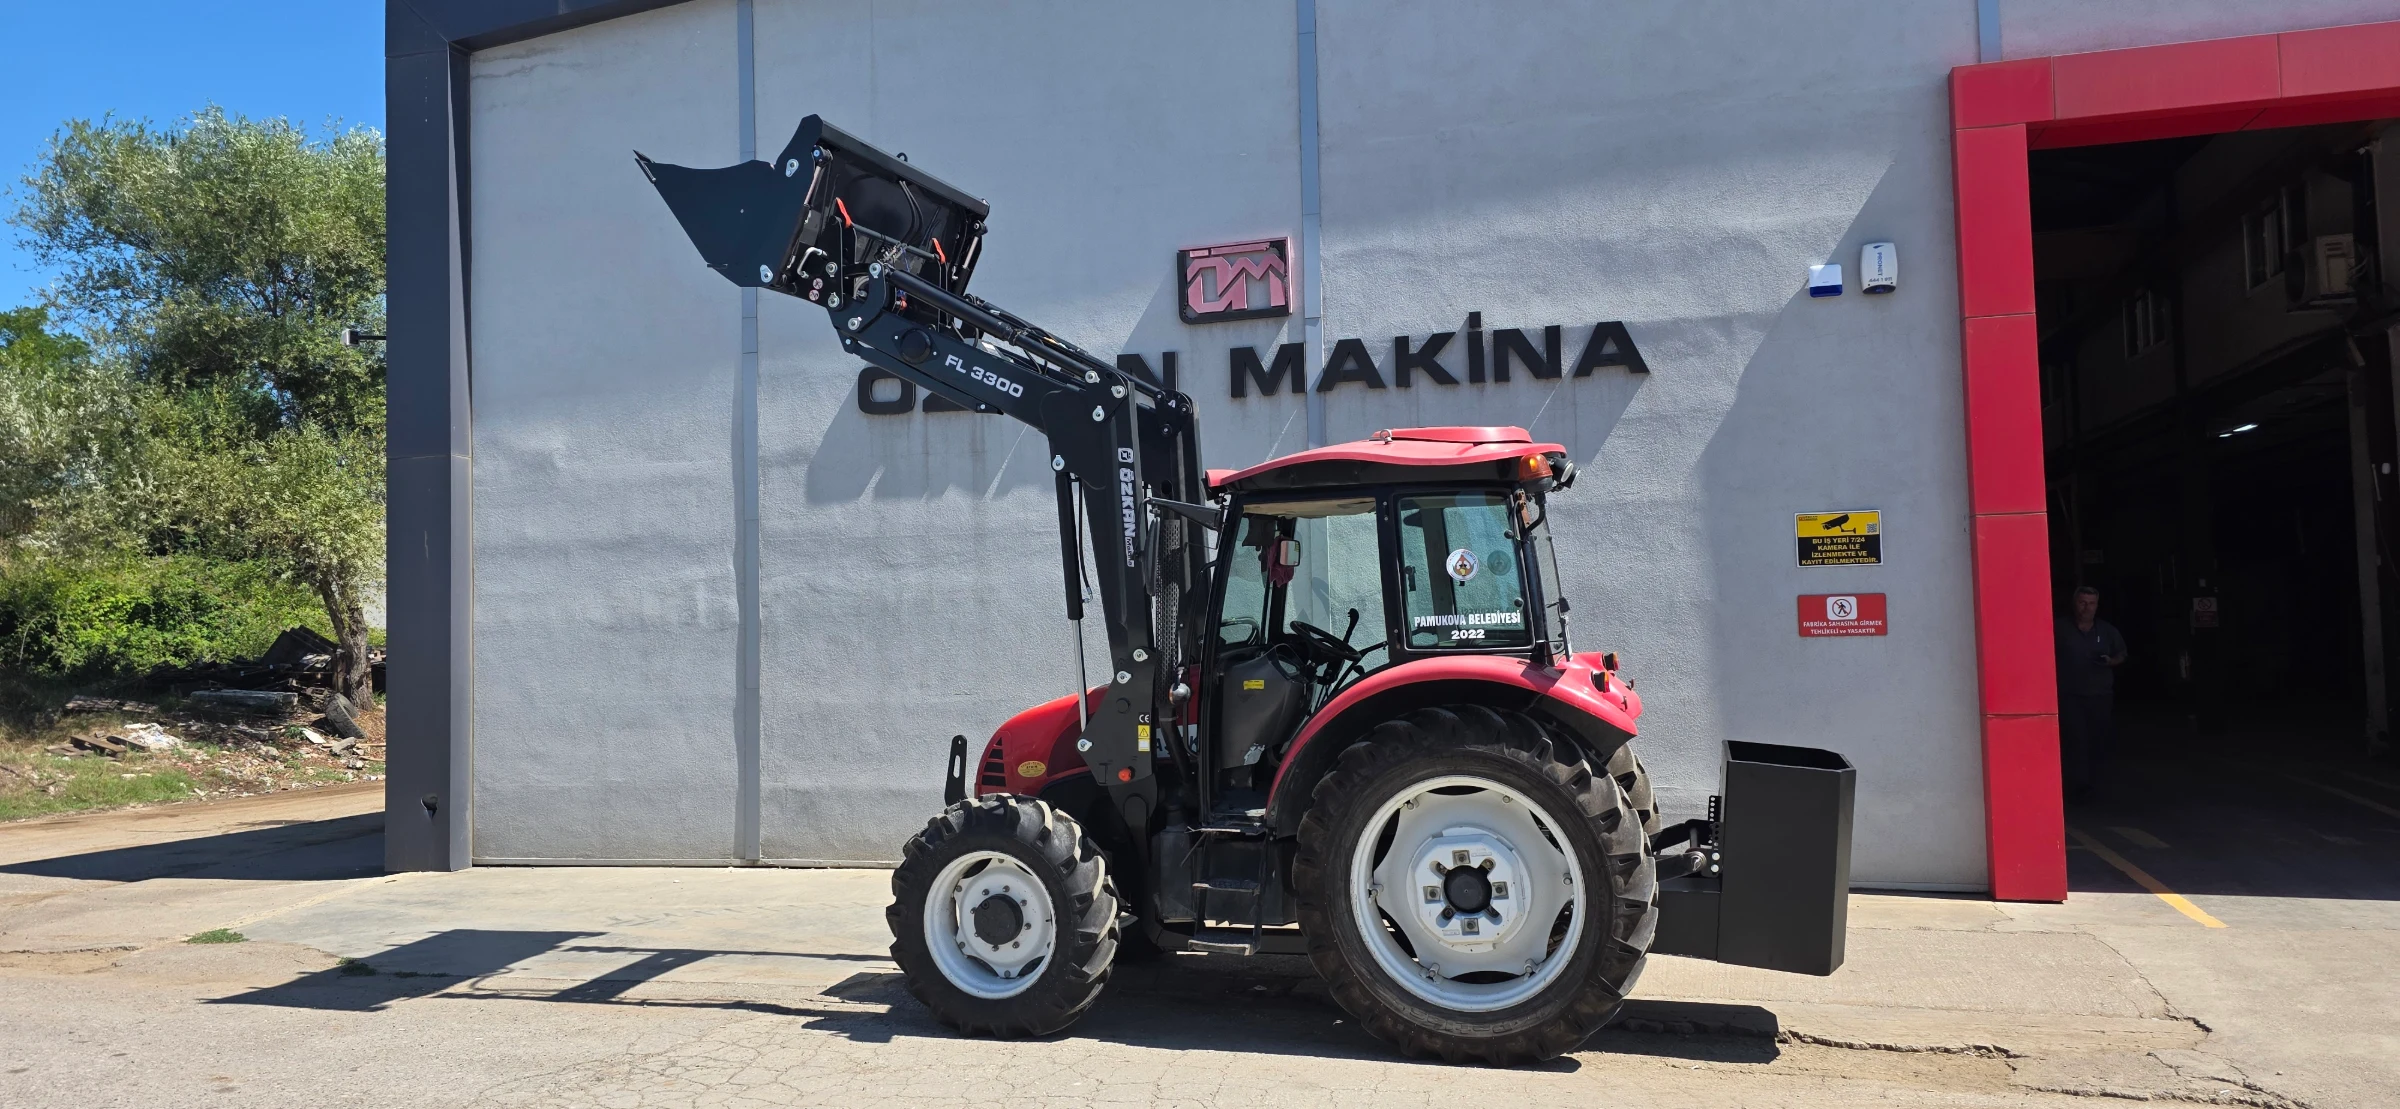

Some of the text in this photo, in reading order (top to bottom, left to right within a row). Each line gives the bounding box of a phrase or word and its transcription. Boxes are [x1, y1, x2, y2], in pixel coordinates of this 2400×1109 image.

[1230, 311, 1650, 398] MAKİNA
[945, 354, 966, 374] FL
[970, 366, 1024, 398] 3300
[1119, 468, 1136, 537] ÖZKAN
[1824, 536, 1832, 545] İŞ
[1832, 536, 1849, 544] YERİ
[1414, 614, 1467, 627] PAMUKOVA
[1468, 610, 1521, 626] BELEDİYESİ
[1451, 629, 1485, 640] 2022
[1138, 714, 1150, 723] CE
